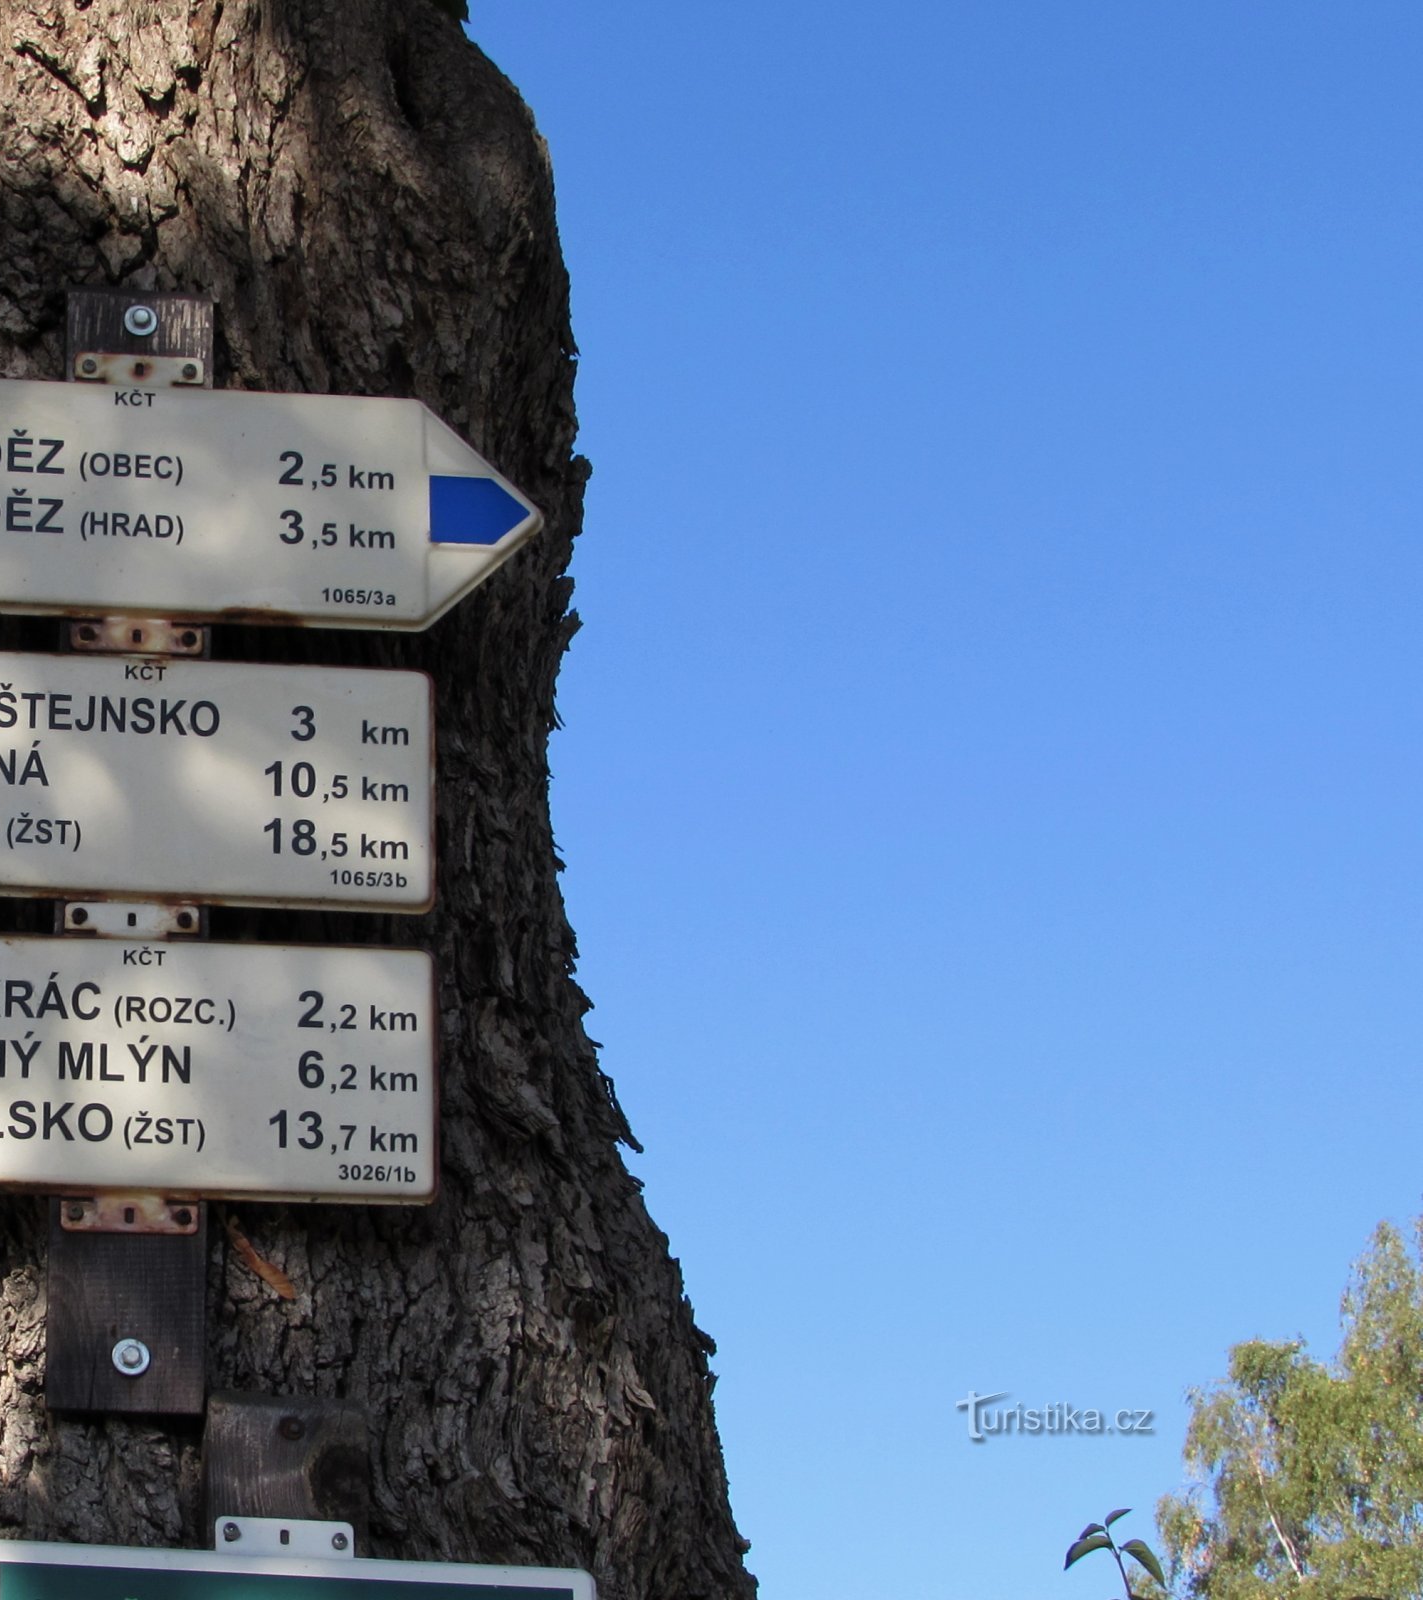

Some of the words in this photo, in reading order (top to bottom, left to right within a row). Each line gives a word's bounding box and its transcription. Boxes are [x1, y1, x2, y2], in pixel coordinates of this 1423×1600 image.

[114, 388, 156, 407] KČT
[79, 452, 184, 487] (OBEC)
[278, 450, 338, 490] 2,5
[349, 464, 394, 490] km
[80, 511, 184, 545] (HRAD)
[279, 509, 338, 550] 3,5
[349, 523, 395, 550] km
[322, 587, 396, 606] 1065/3a
[124, 660, 167, 682] KČT
[290, 705, 316, 742] 3
[361, 719, 409, 746] km
[264, 760, 349, 804] 10,5
[361, 776, 409, 803] km
[6, 814, 81, 853] (ŽST)
[263, 817, 348, 862] 18,5
[360, 833, 409, 860] km
[330, 869, 408, 888] 1065/3b
[123, 946, 167, 966] KČT
[114, 995, 236, 1033] (ROZC.)
[297, 990, 357, 1034] 2,2
[370, 1004, 417, 1032] km
[58, 1034, 192, 1085] MLÝN
[298, 1050, 357, 1094] 6,2
[370, 1064, 418, 1092] km
[123, 1112, 206, 1153] (ŽST)
[269, 1109, 357, 1155] 13,7
[370, 1125, 418, 1153] km
[338, 1164, 416, 1183] 3026/1b
